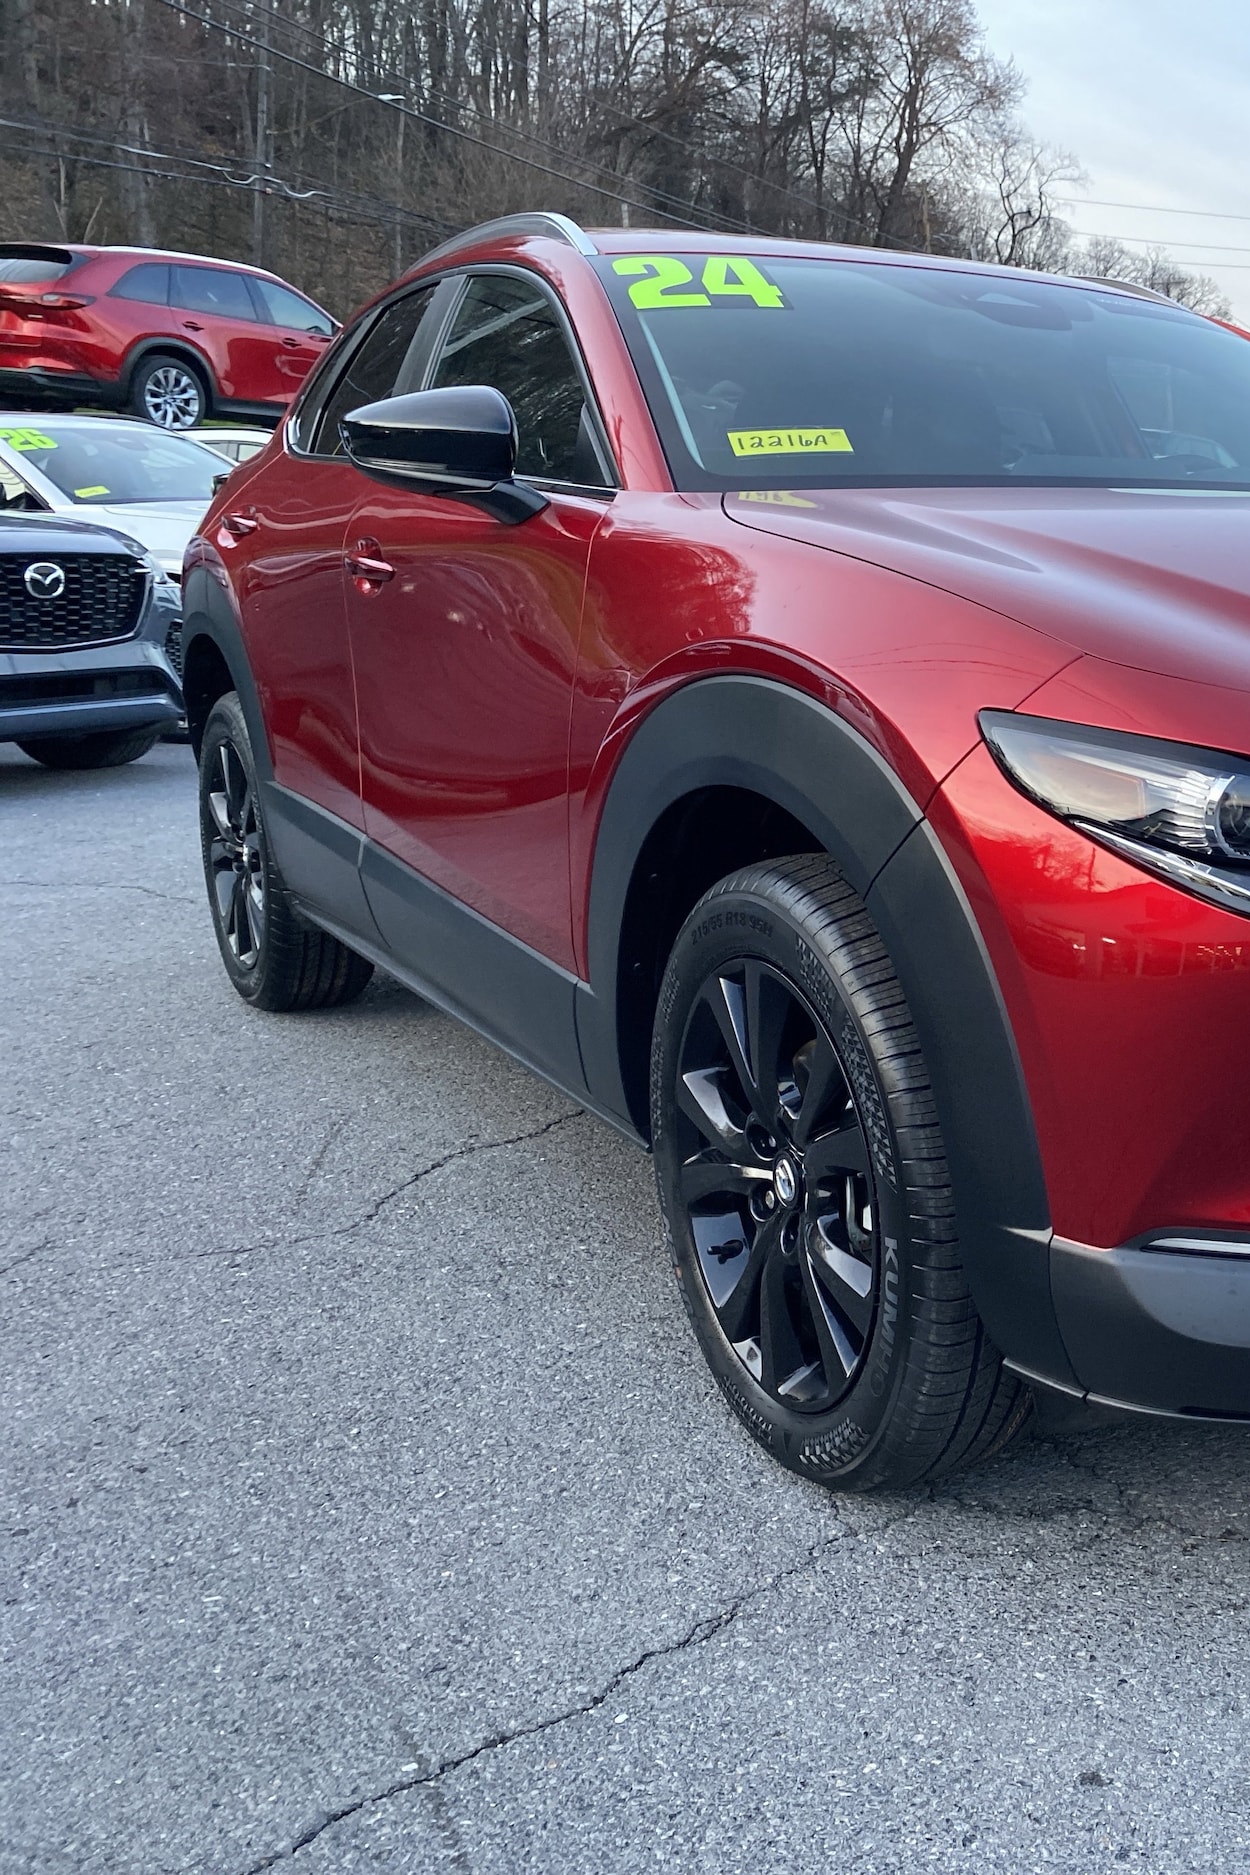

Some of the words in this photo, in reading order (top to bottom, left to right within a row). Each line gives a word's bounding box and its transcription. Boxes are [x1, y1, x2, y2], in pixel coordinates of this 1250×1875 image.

[612, 256, 784, 310] 24
[0, 427, 59, 452] 26
[737, 434, 829, 451] 12216A
[870, 1236, 899, 1398] KUMHO
